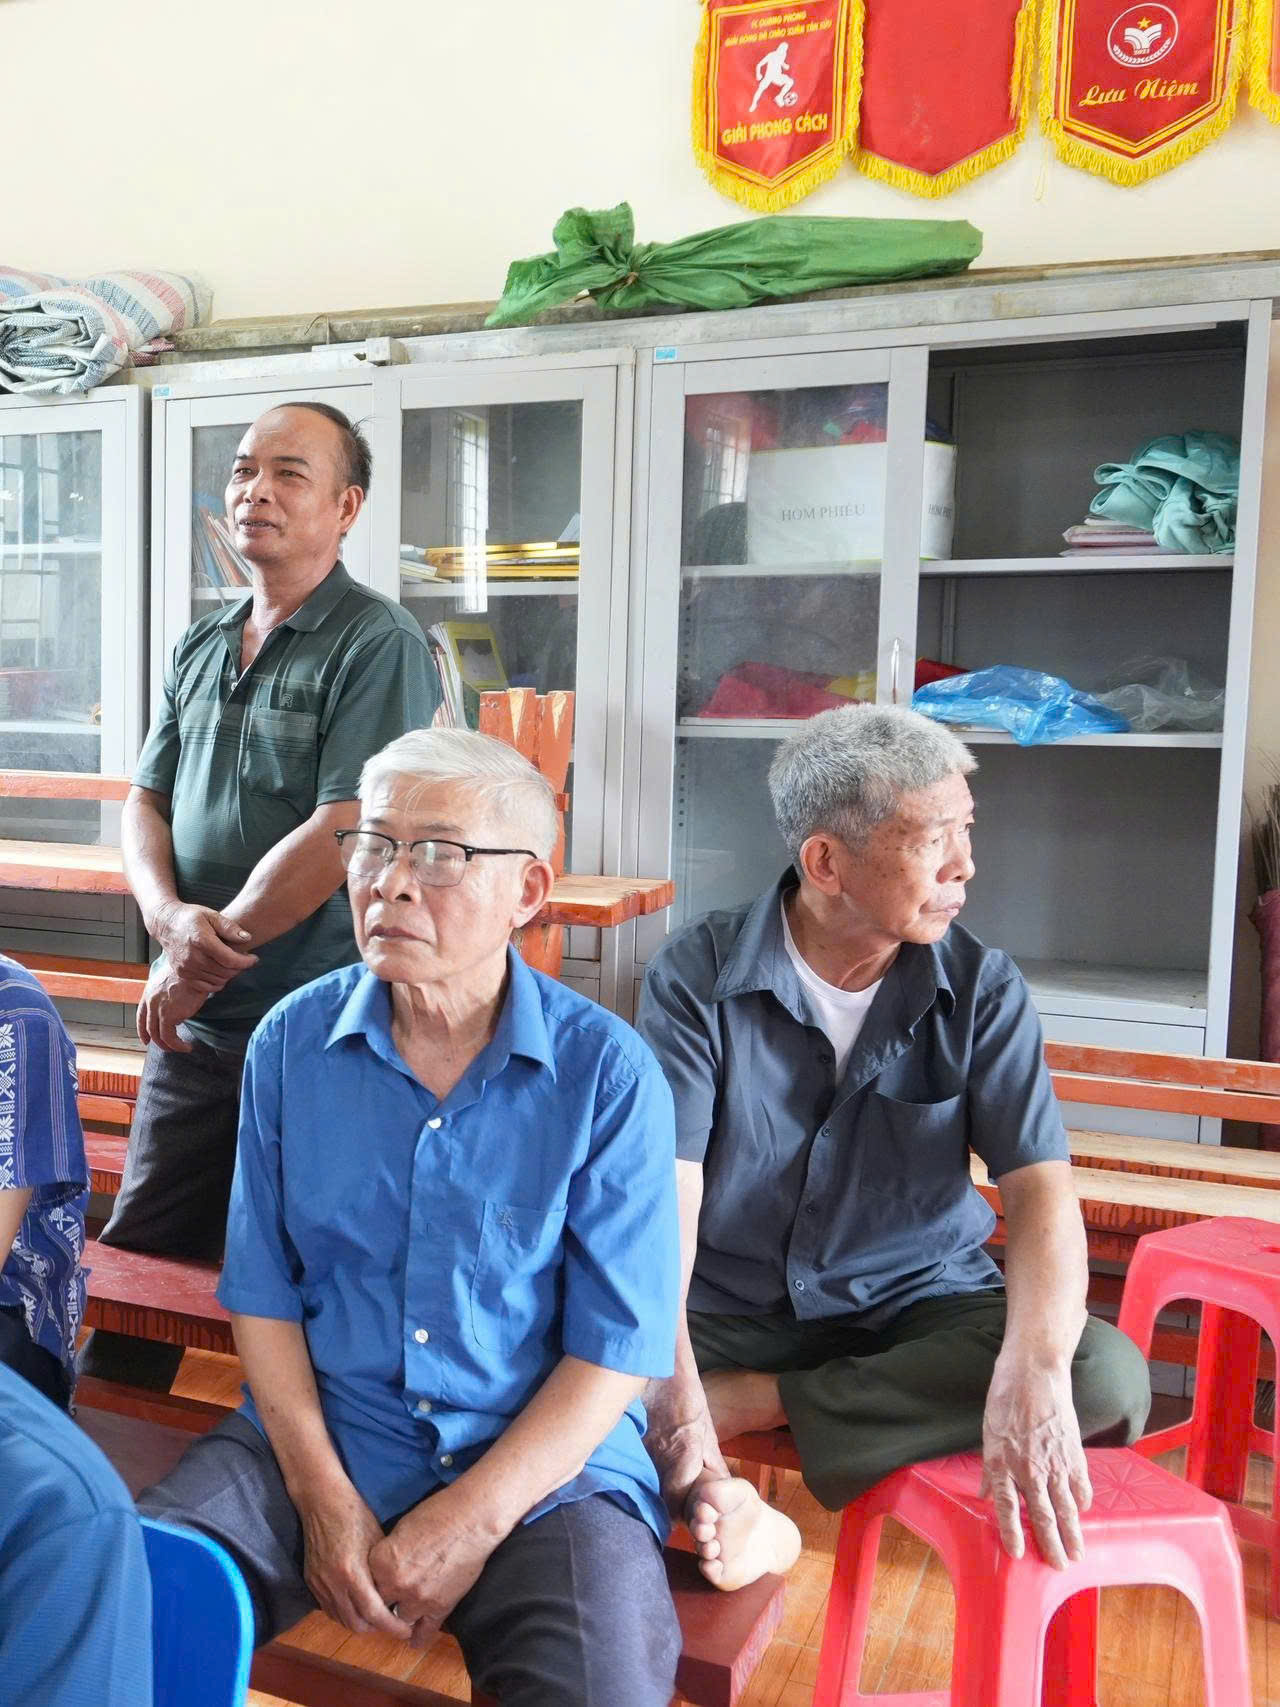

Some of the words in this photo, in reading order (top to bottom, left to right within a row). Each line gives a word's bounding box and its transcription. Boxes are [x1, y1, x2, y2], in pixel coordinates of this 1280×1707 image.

[1078, 84, 1127, 107] Lưu
[1134, 78, 1200, 103] Niệm
[721, 120, 747, 146] GIẢI
[749, 117, 793, 142] PHONG
[794, 109, 828, 134] CÁCH
